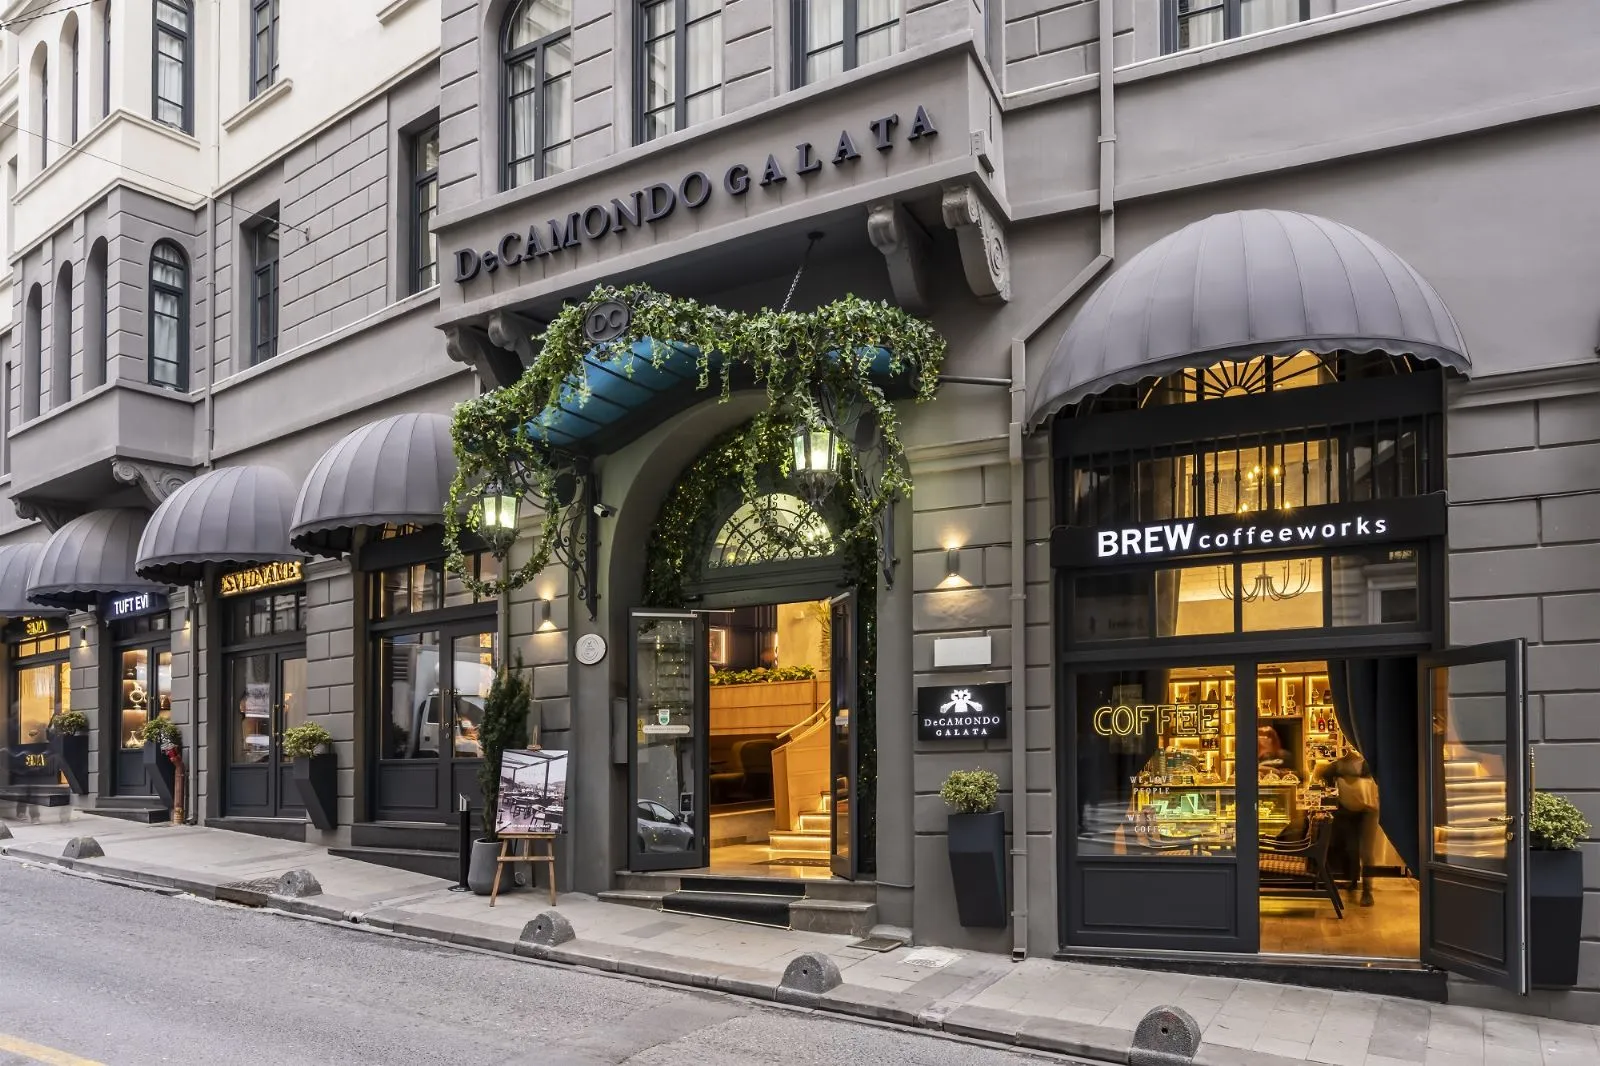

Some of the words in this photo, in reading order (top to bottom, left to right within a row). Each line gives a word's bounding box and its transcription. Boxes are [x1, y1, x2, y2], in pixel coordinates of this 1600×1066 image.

[454, 171, 712, 283] DeCAMONDO
[724, 104, 938, 195] GALATA
[1097, 523, 1195, 557] BREW
[1199, 517, 1387, 548] coffeeworks
[114, 597, 134, 615] TUFT
[924, 716, 1000, 727] DeCAMONDO
[1093, 703, 1219, 736] COFFEE
[936, 728, 988, 737] GALATA
[1129, 775, 1144, 784] WE
[1133, 787, 1170, 795] PEOPLE
